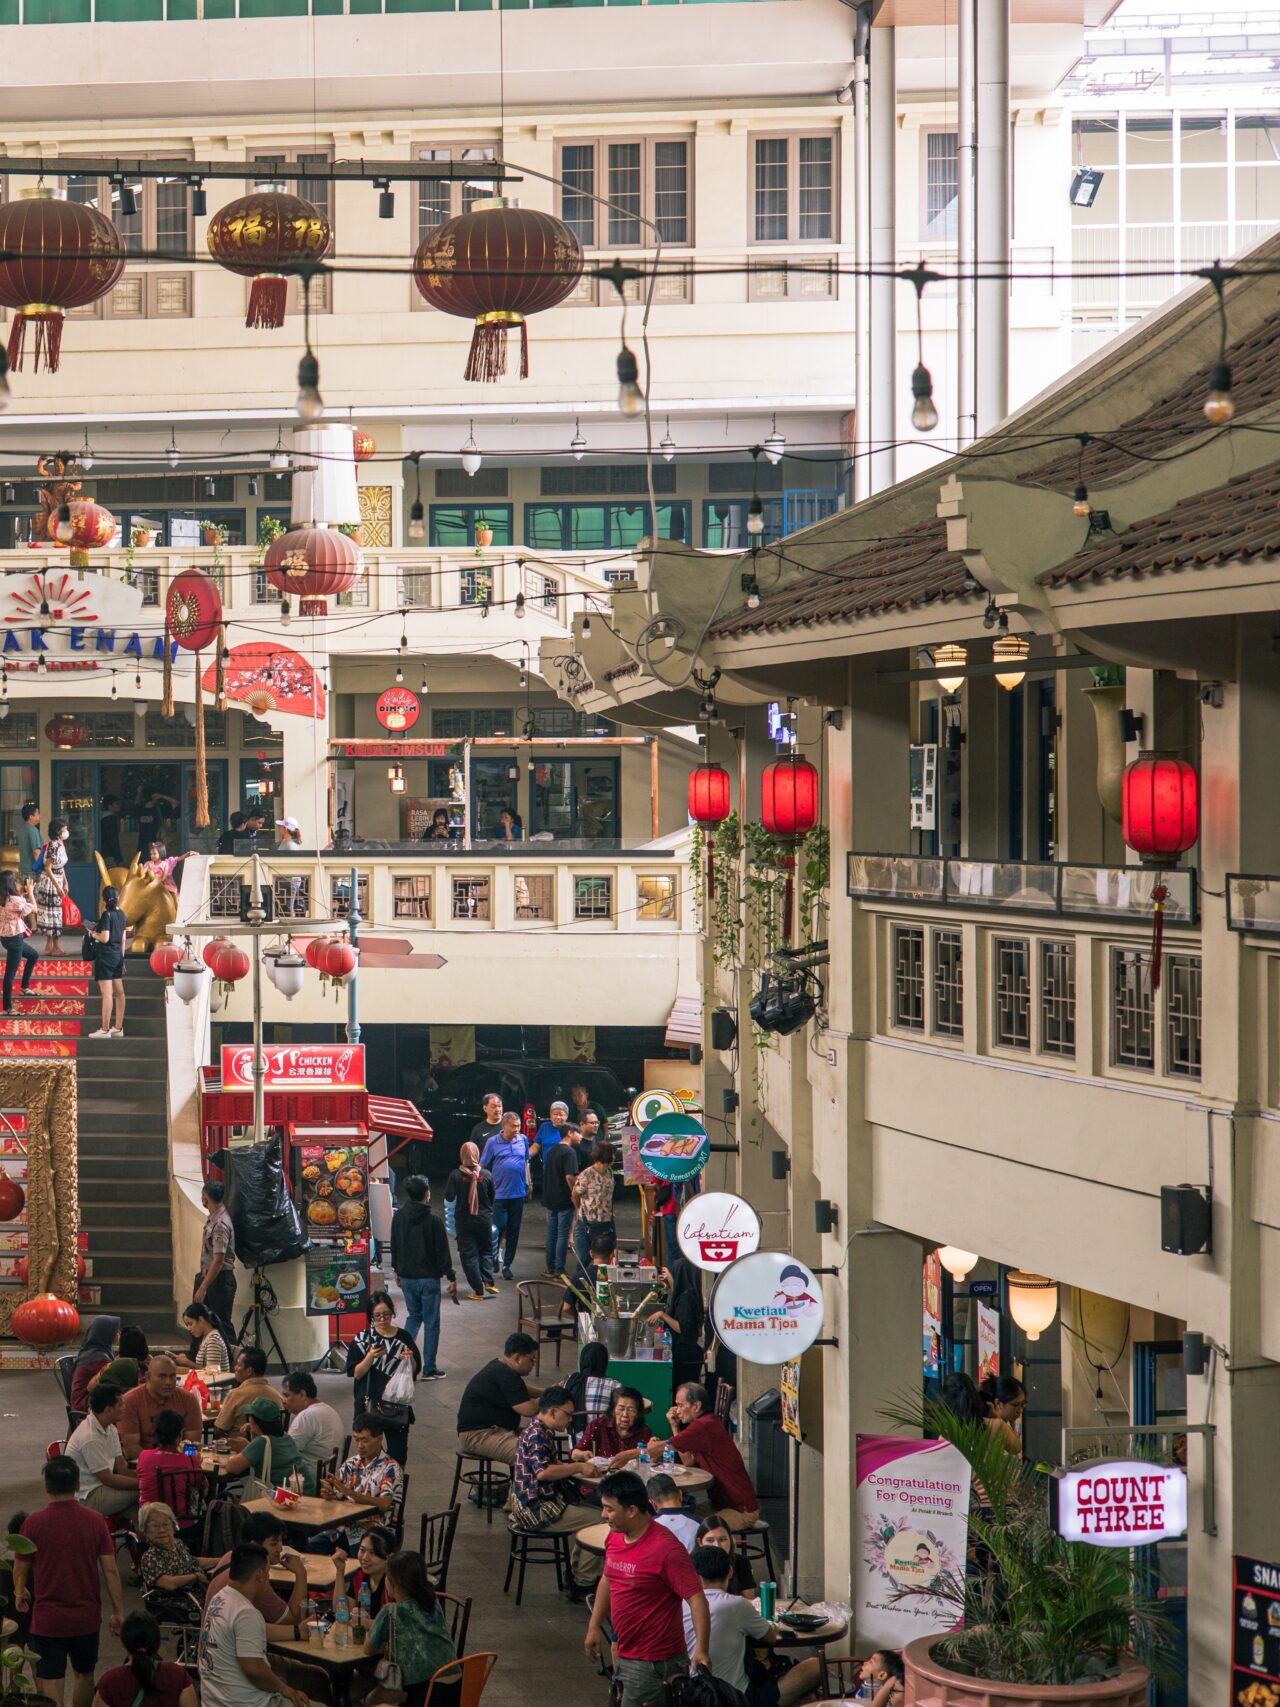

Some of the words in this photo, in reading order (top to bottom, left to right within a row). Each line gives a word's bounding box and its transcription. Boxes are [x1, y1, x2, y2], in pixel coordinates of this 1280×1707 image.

[70, 626, 180, 665] ENAM
[345, 744, 388, 757] KEDAI
[391, 744, 446, 756] DIMSUM
[298, 1056, 333, 1066] CHICKEN
[644, 1161, 669, 1180] Lumpia
[670, 1165, 702, 1181] Semarang
[733, 1306, 787, 1320] Kwetiau
[723, 1319, 765, 1330] Mama
[769, 1317, 798, 1331] Tjoa
[867, 1474, 961, 1492] Congratulation
[1077, 1476, 1165, 1505] COUNT
[876, 1489, 896, 1501] For
[899, 1491, 953, 1508] Opening
[1077, 1504, 1165, 1533] THREE
[889, 1564, 910, 1573] Mama
[911, 1566, 925, 1574] Tjoa
[894, 1558, 920, 1567] Kwetiau
[1253, 1564, 1280, 1589] SNA
